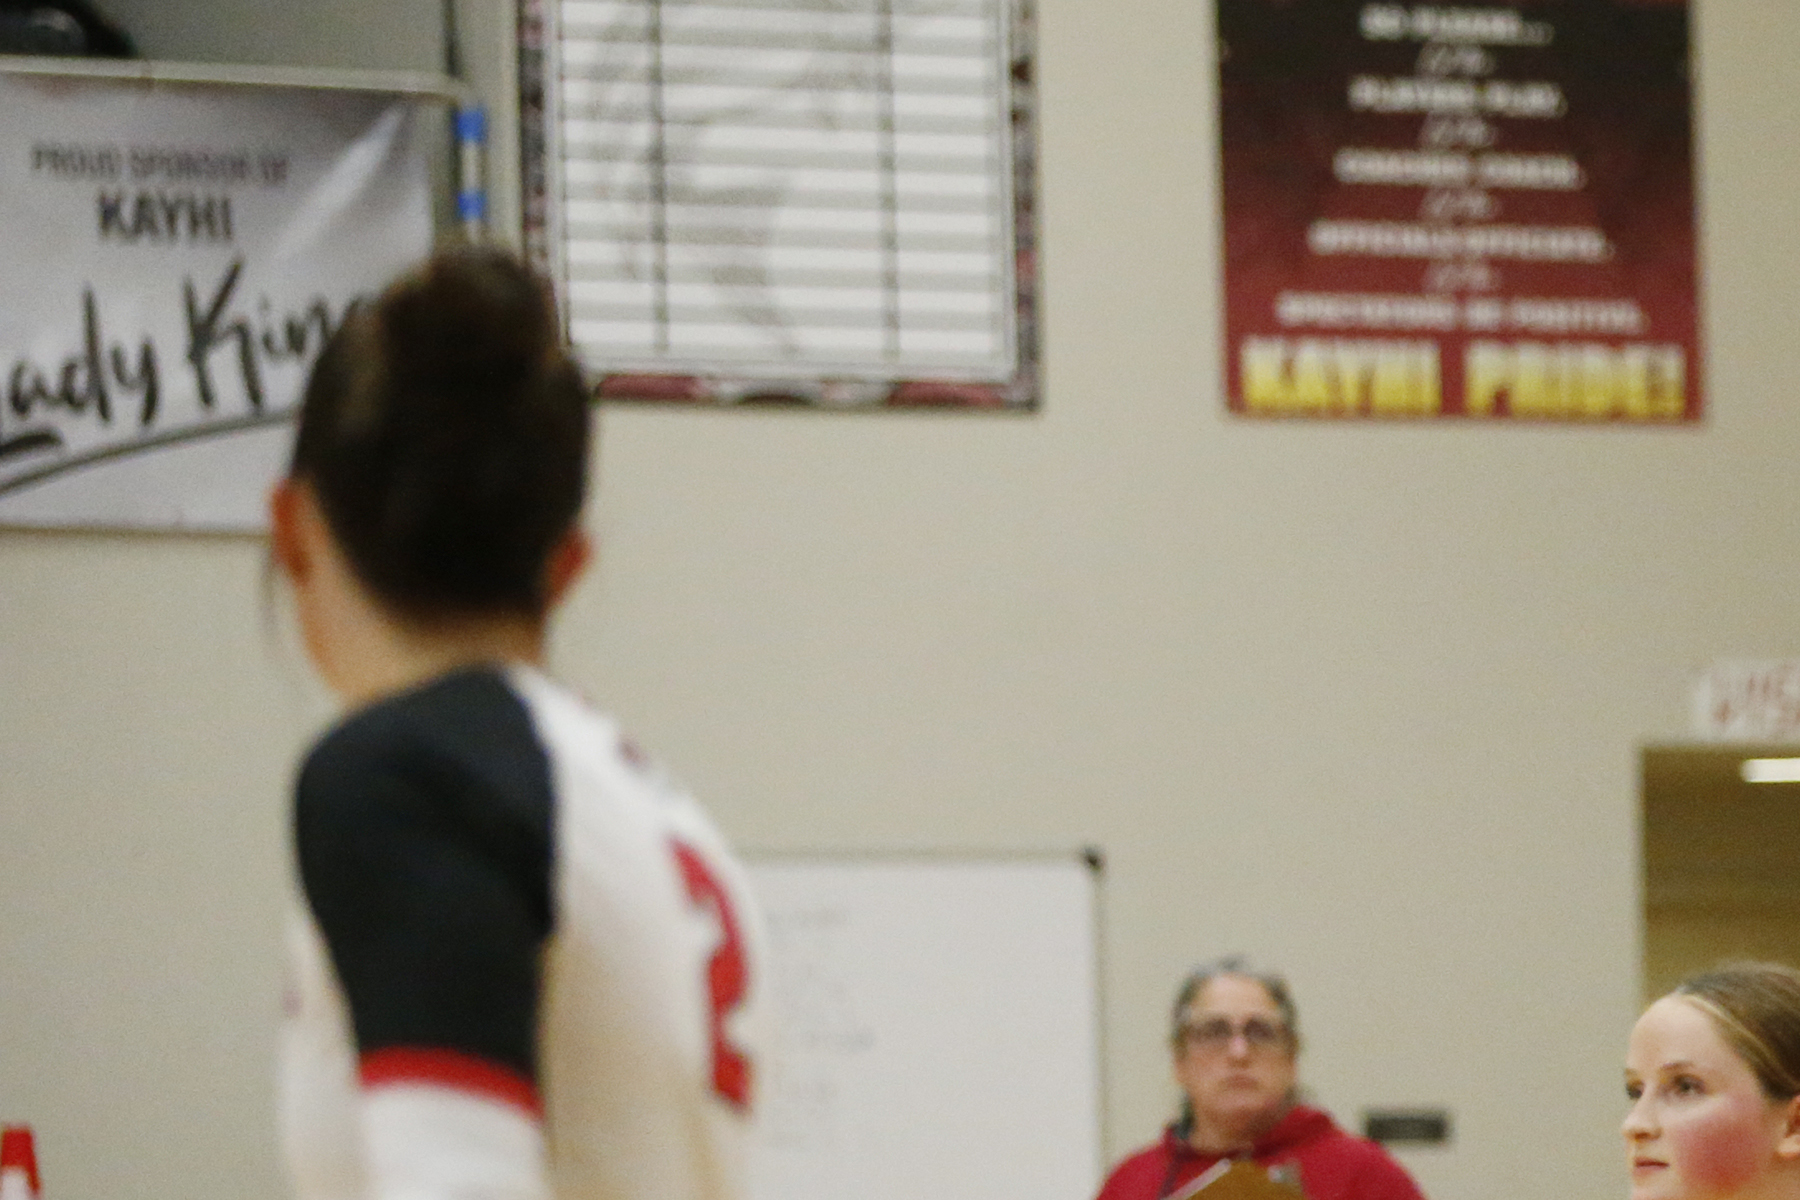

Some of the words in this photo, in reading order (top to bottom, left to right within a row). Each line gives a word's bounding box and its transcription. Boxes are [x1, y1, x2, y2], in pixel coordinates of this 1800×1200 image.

[30, 143, 124, 174] PROUD
[129, 147, 247, 183] SPONSOR
[254, 152, 290, 183] OF
[97, 192, 234, 244] KAYHI
[0, 281, 158, 428] ady
[1241, 336, 1441, 416] KAYHI
[667, 834, 756, 1119] 2
